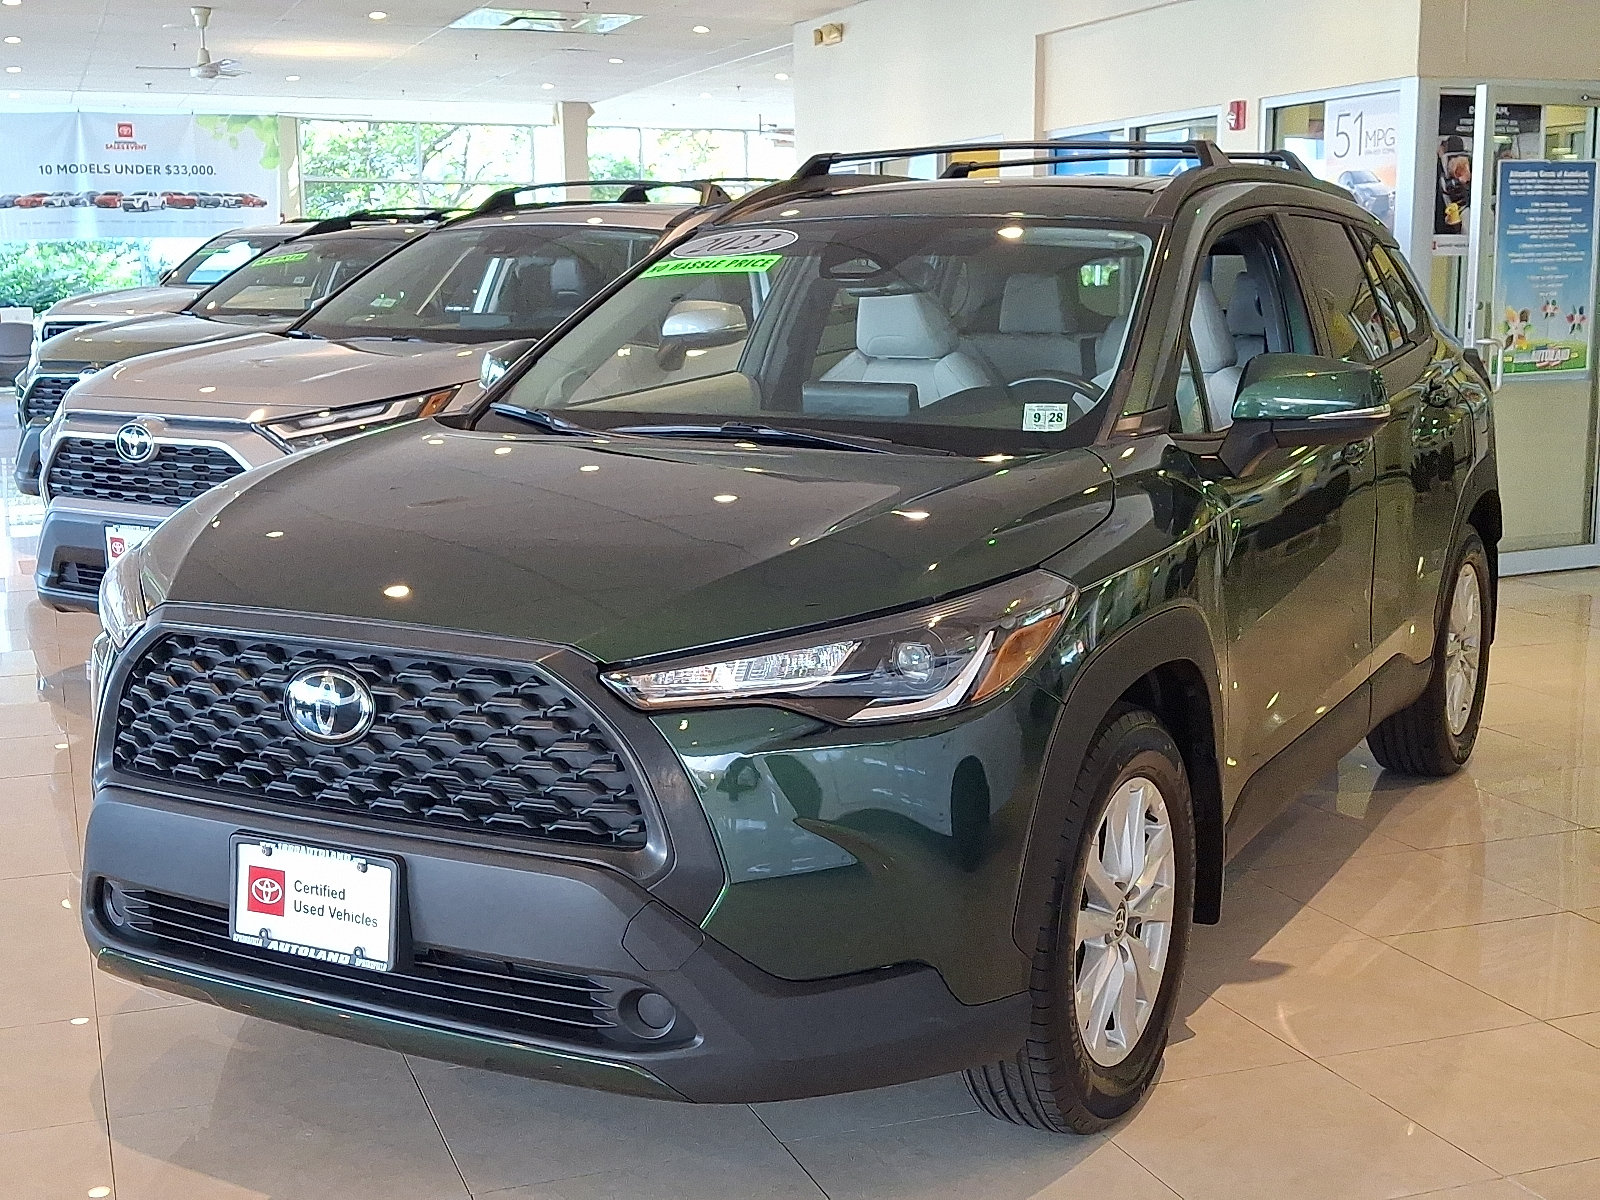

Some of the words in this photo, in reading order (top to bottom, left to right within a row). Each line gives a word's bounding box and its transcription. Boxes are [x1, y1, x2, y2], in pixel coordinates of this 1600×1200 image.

[1334, 111, 1363, 158] 51
[1365, 127, 1396, 148] MPG
[38, 164, 53, 175] 10
[57, 163, 111, 175] MODELS
[114, 164, 162, 176] UNDER
[165, 163, 217, 177] $33,000.
[687, 233, 782, 254] 2023
[669, 260, 727, 271] HASSLE
[725, 258, 775, 268] PRICE
[1033, 412, 1041, 423] 9
[1048, 412, 1063, 423] 28
[294, 880, 346, 901] Certified
[294, 900, 325, 917] Used
[328, 906, 378, 928] Vehicles
[267, 941, 351, 965] AUTOLAND
